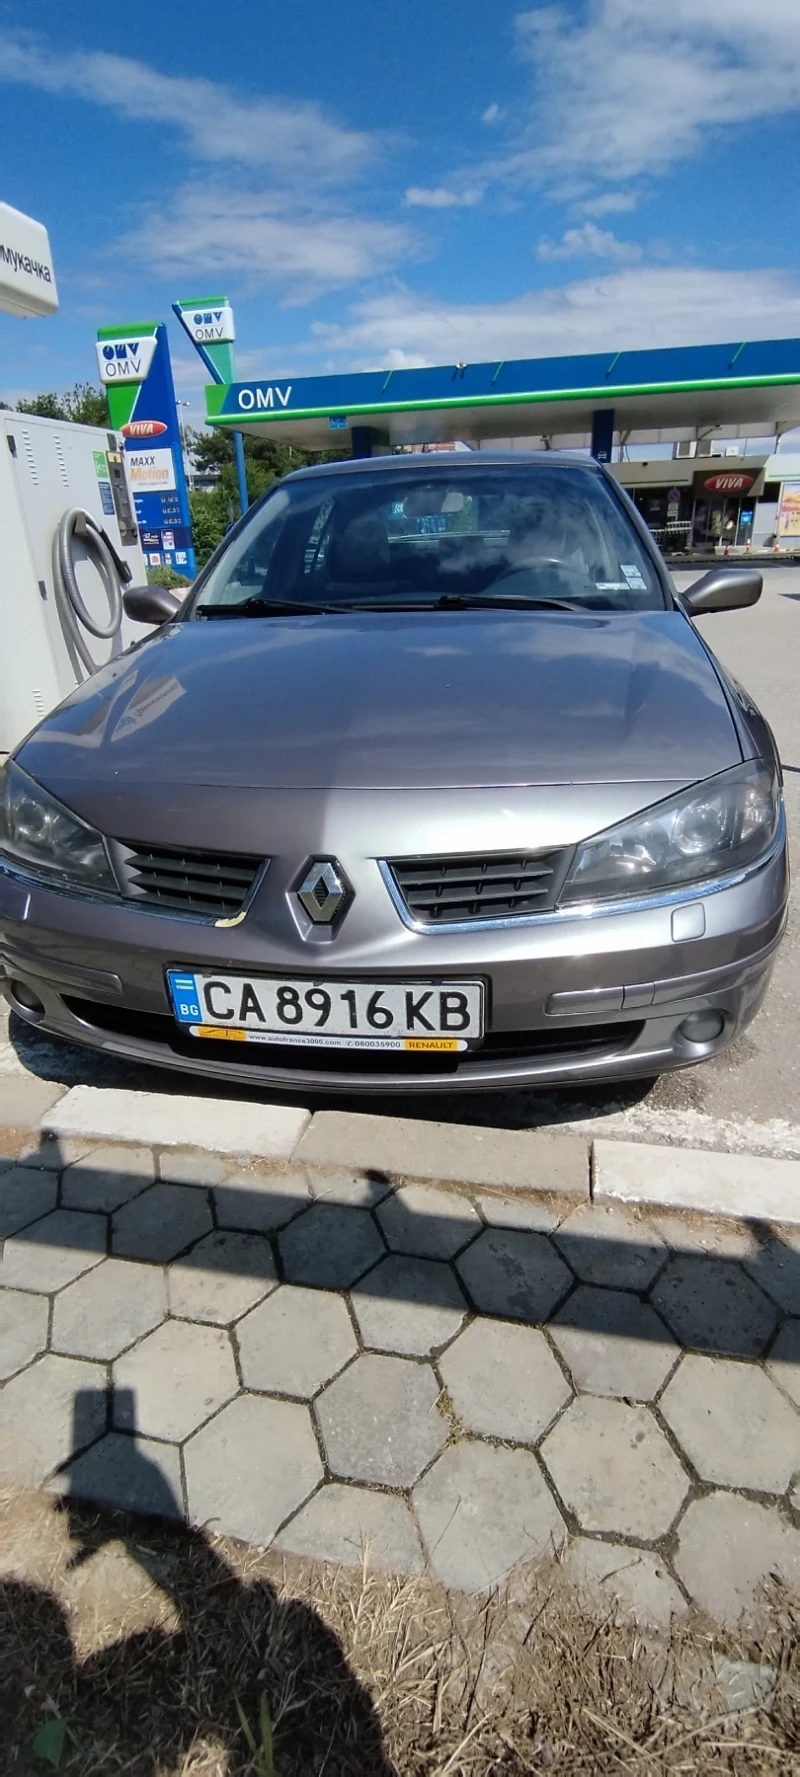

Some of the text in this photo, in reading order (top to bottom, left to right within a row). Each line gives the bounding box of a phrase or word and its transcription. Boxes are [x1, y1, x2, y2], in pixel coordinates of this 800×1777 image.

[0, 245, 52, 283] мукачка
[195, 327, 224, 340] OMV
[105, 359, 142, 377] OMV
[238, 386, 292, 410] OMV
[129, 423, 154, 436] VIVA
[130, 456, 155, 467] MAXX
[130, 467, 169, 480] Motion
[715, 477, 743, 489] VIVA
[180, 1003, 199, 1016] BG
[203, 981, 471, 1031] CA 8916 KB
[249, 1033, 341, 1046] www.autofrance3000.com
[408, 1041, 454, 1049] RENAULT
